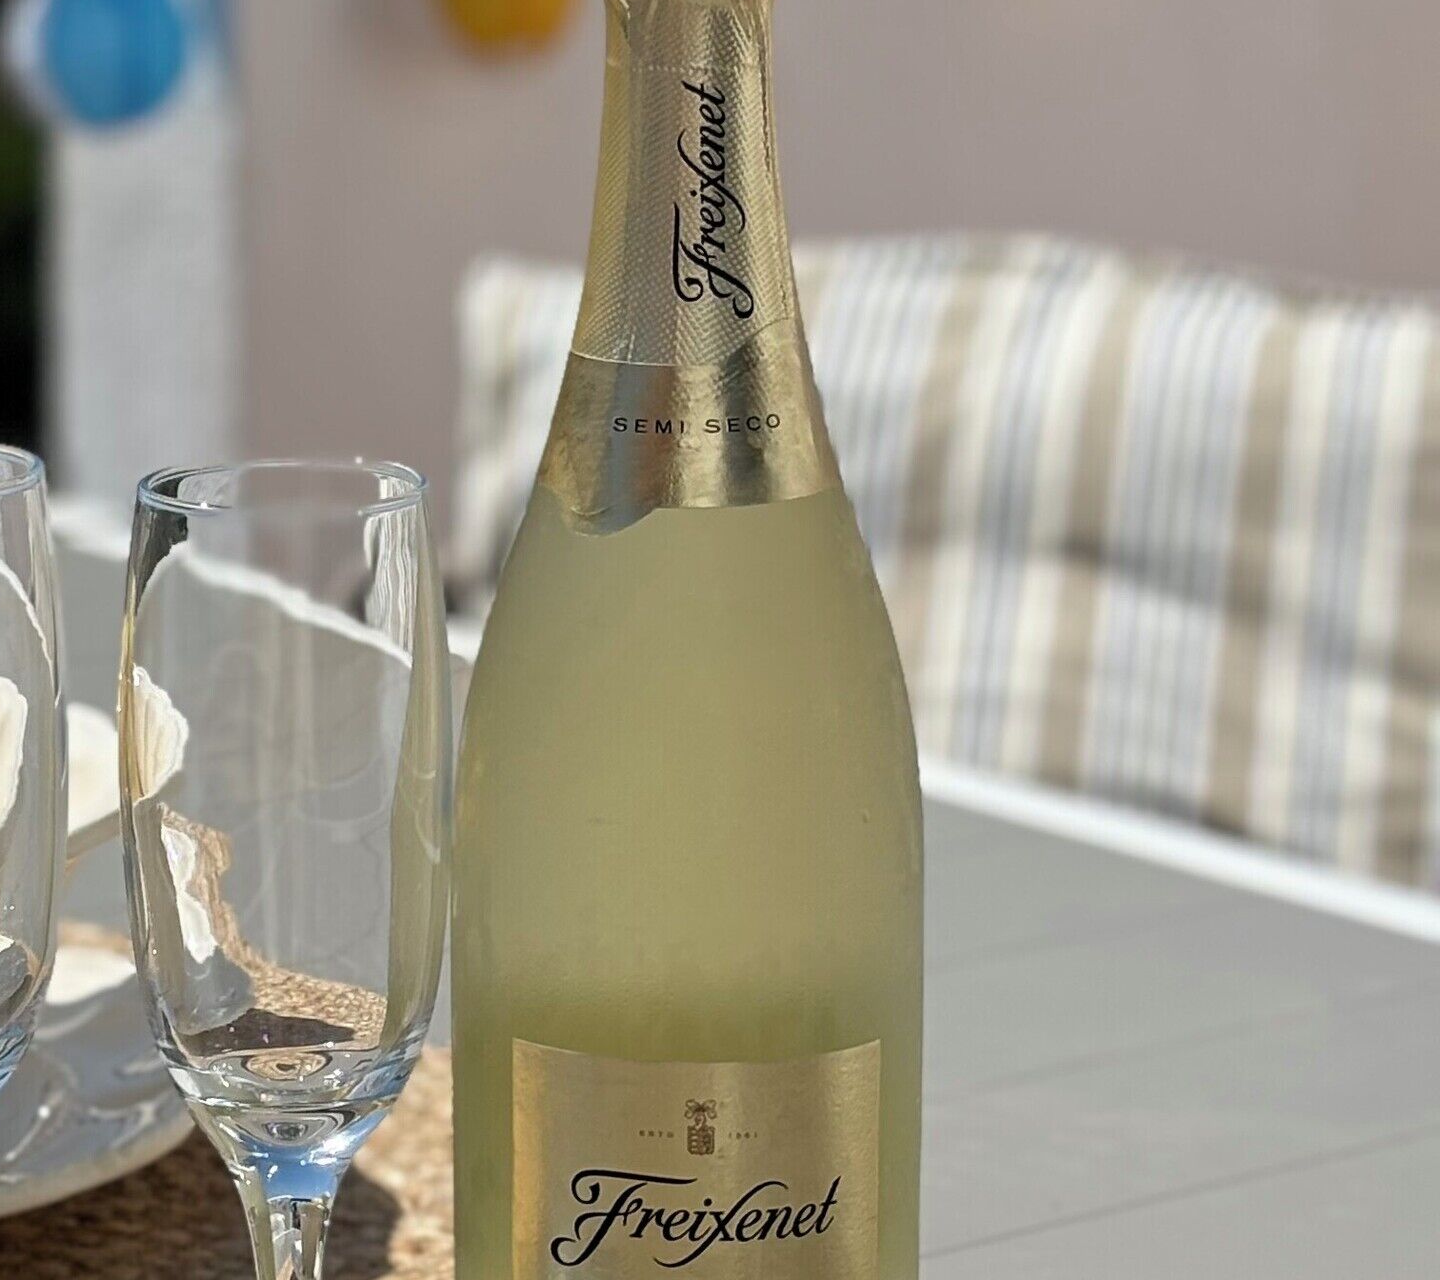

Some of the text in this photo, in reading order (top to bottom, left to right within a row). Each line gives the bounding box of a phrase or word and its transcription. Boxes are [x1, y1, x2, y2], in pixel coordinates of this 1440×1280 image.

[672, 80, 755, 319] Freixenet
[612, 413, 781, 435] SEMI SECO
[550, 1169, 841, 1268] Freixenet
